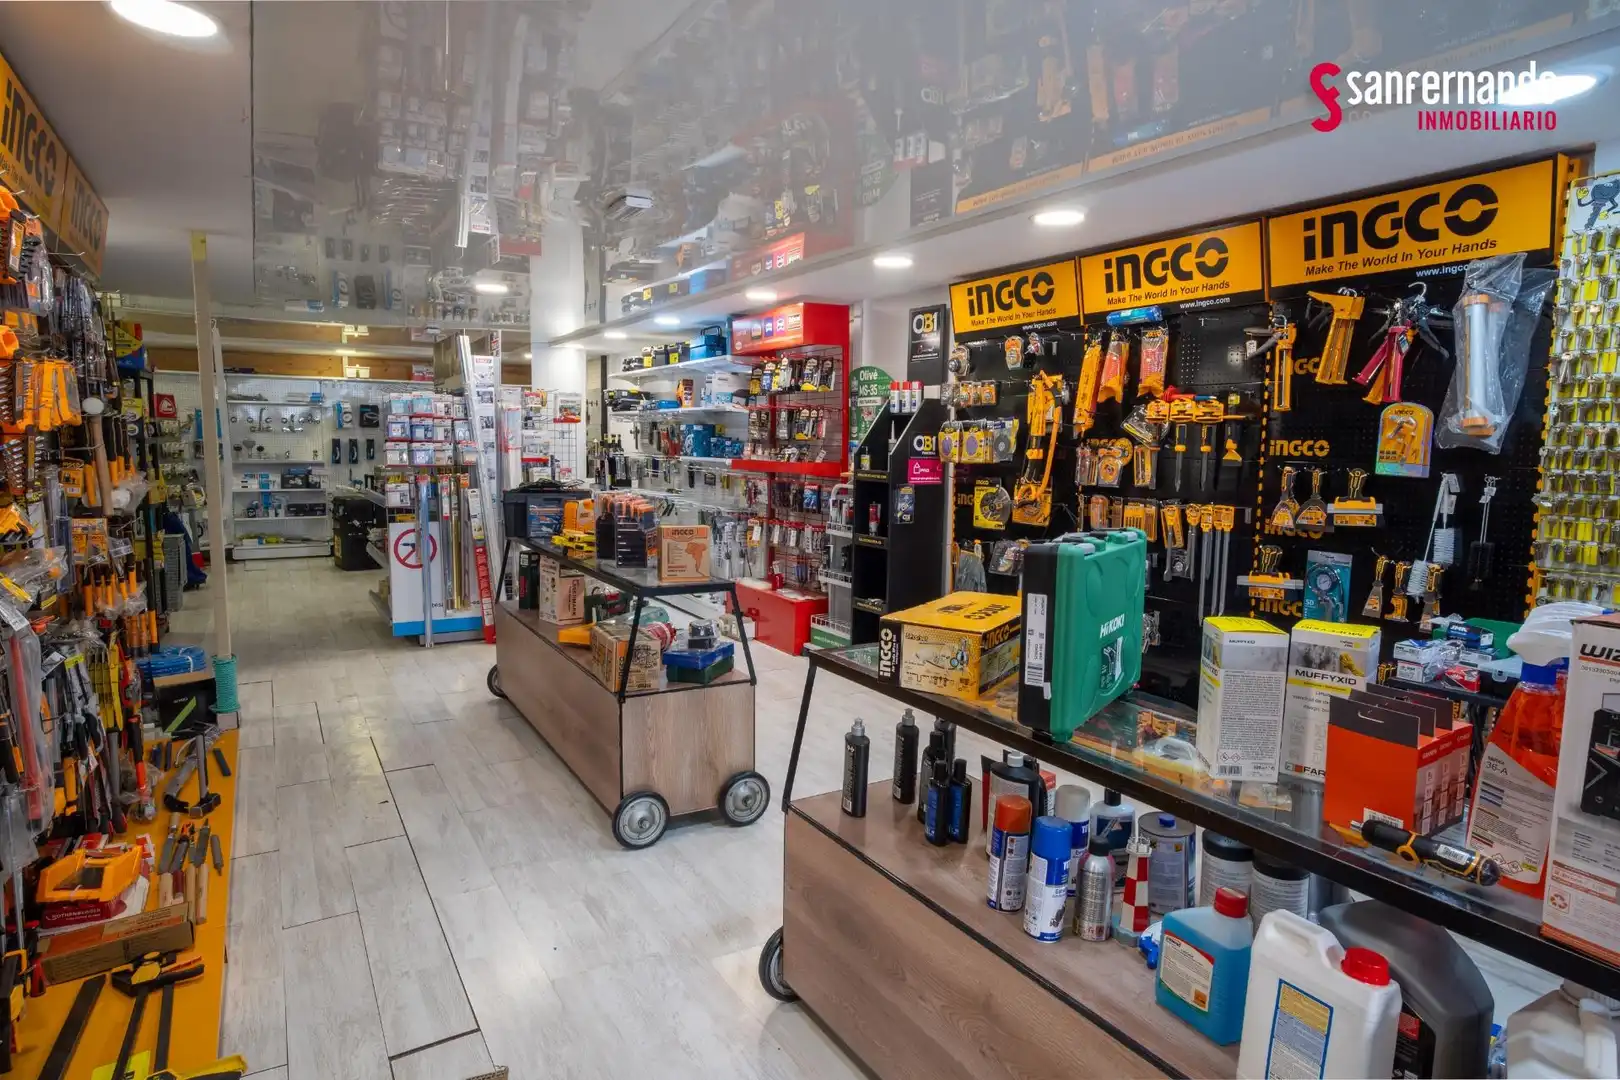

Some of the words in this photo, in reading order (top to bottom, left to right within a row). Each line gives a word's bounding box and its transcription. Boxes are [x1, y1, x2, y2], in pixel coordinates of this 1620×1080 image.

[1305, 263, 1333, 276] Make
[1338, 260, 1358, 271] The
[1362, 254, 1398, 268] World
[1401, 251, 1413, 262] In
[1417, 247, 1448, 260] Your
[1452, 239, 1497, 255] Hands
[1107, 296, 1127, 306] Make
[1128, 293, 1143, 302] The
[1144, 290, 1168, 301] World
[1170, 287, 1178, 297] In
[1179, 284, 1200, 297] Your
[1202, 280, 1230, 292] Hands
[1179, 296, 1231, 310] www.ingco.com
[985, 317, 996, 325] The
[997, 314, 1014, 323] World
[1015, 312, 1021, 320] In
[1022, 310, 1035, 320] Your
[1036, 307, 1057, 317] Hands
[1295, 669, 1357, 685] MUFFYXID
